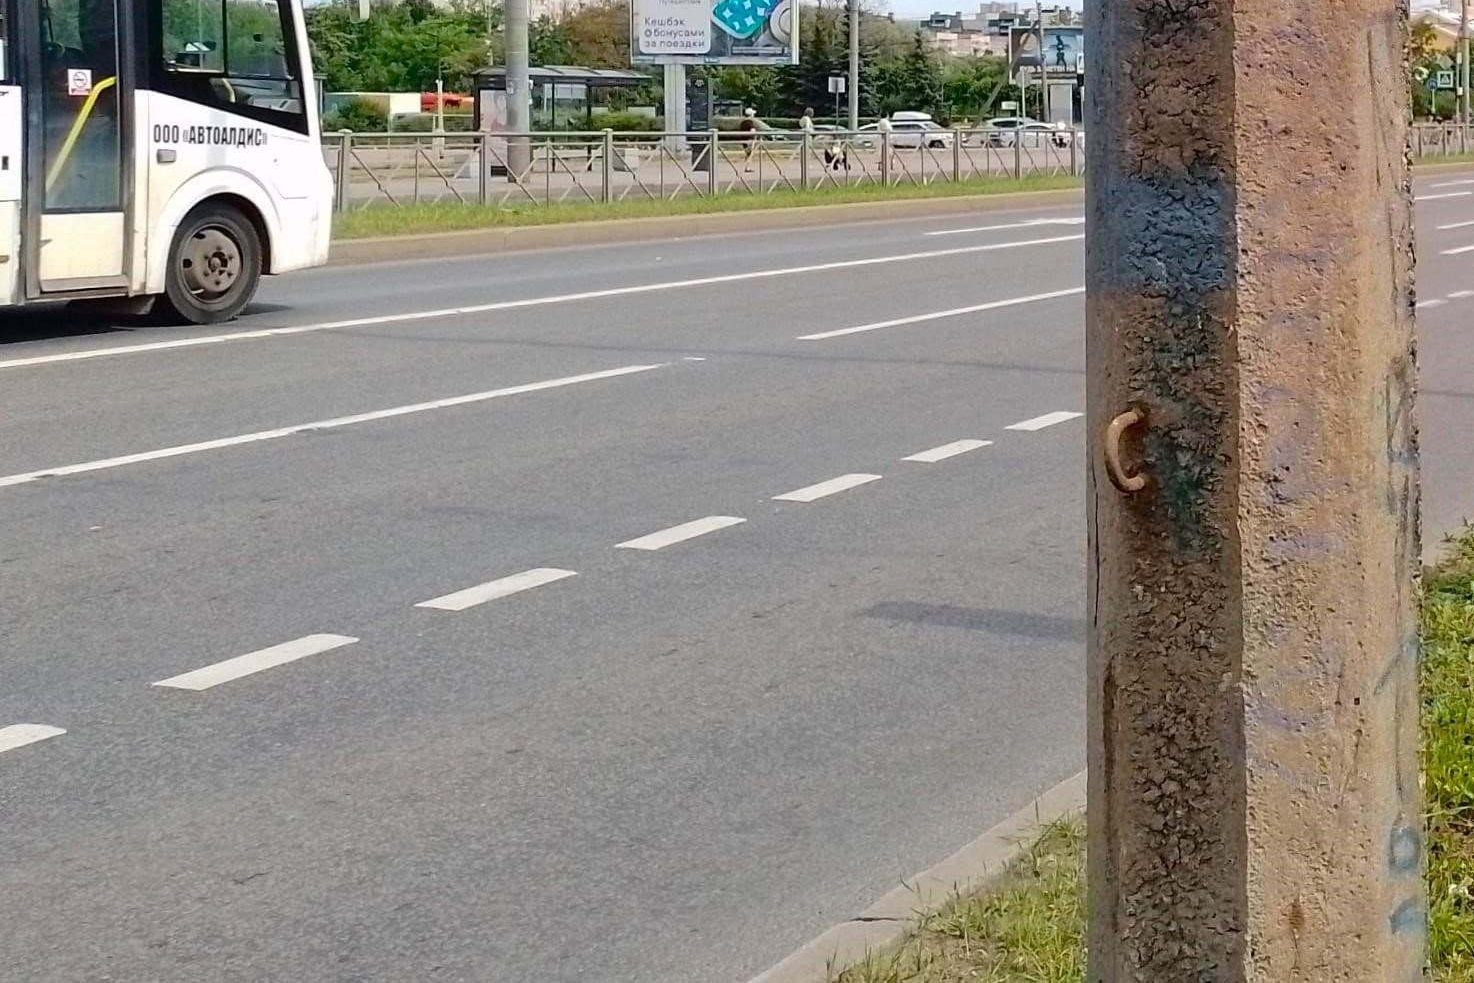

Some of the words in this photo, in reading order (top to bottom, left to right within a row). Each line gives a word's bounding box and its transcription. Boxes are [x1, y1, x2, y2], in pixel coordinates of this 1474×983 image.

[644, 17, 685, 26] Кешбэк
[659, 40, 705, 48] поездки
[153, 124, 180, 144] ООО
[183, 126, 267, 148] «АВТОАЛДИС»
